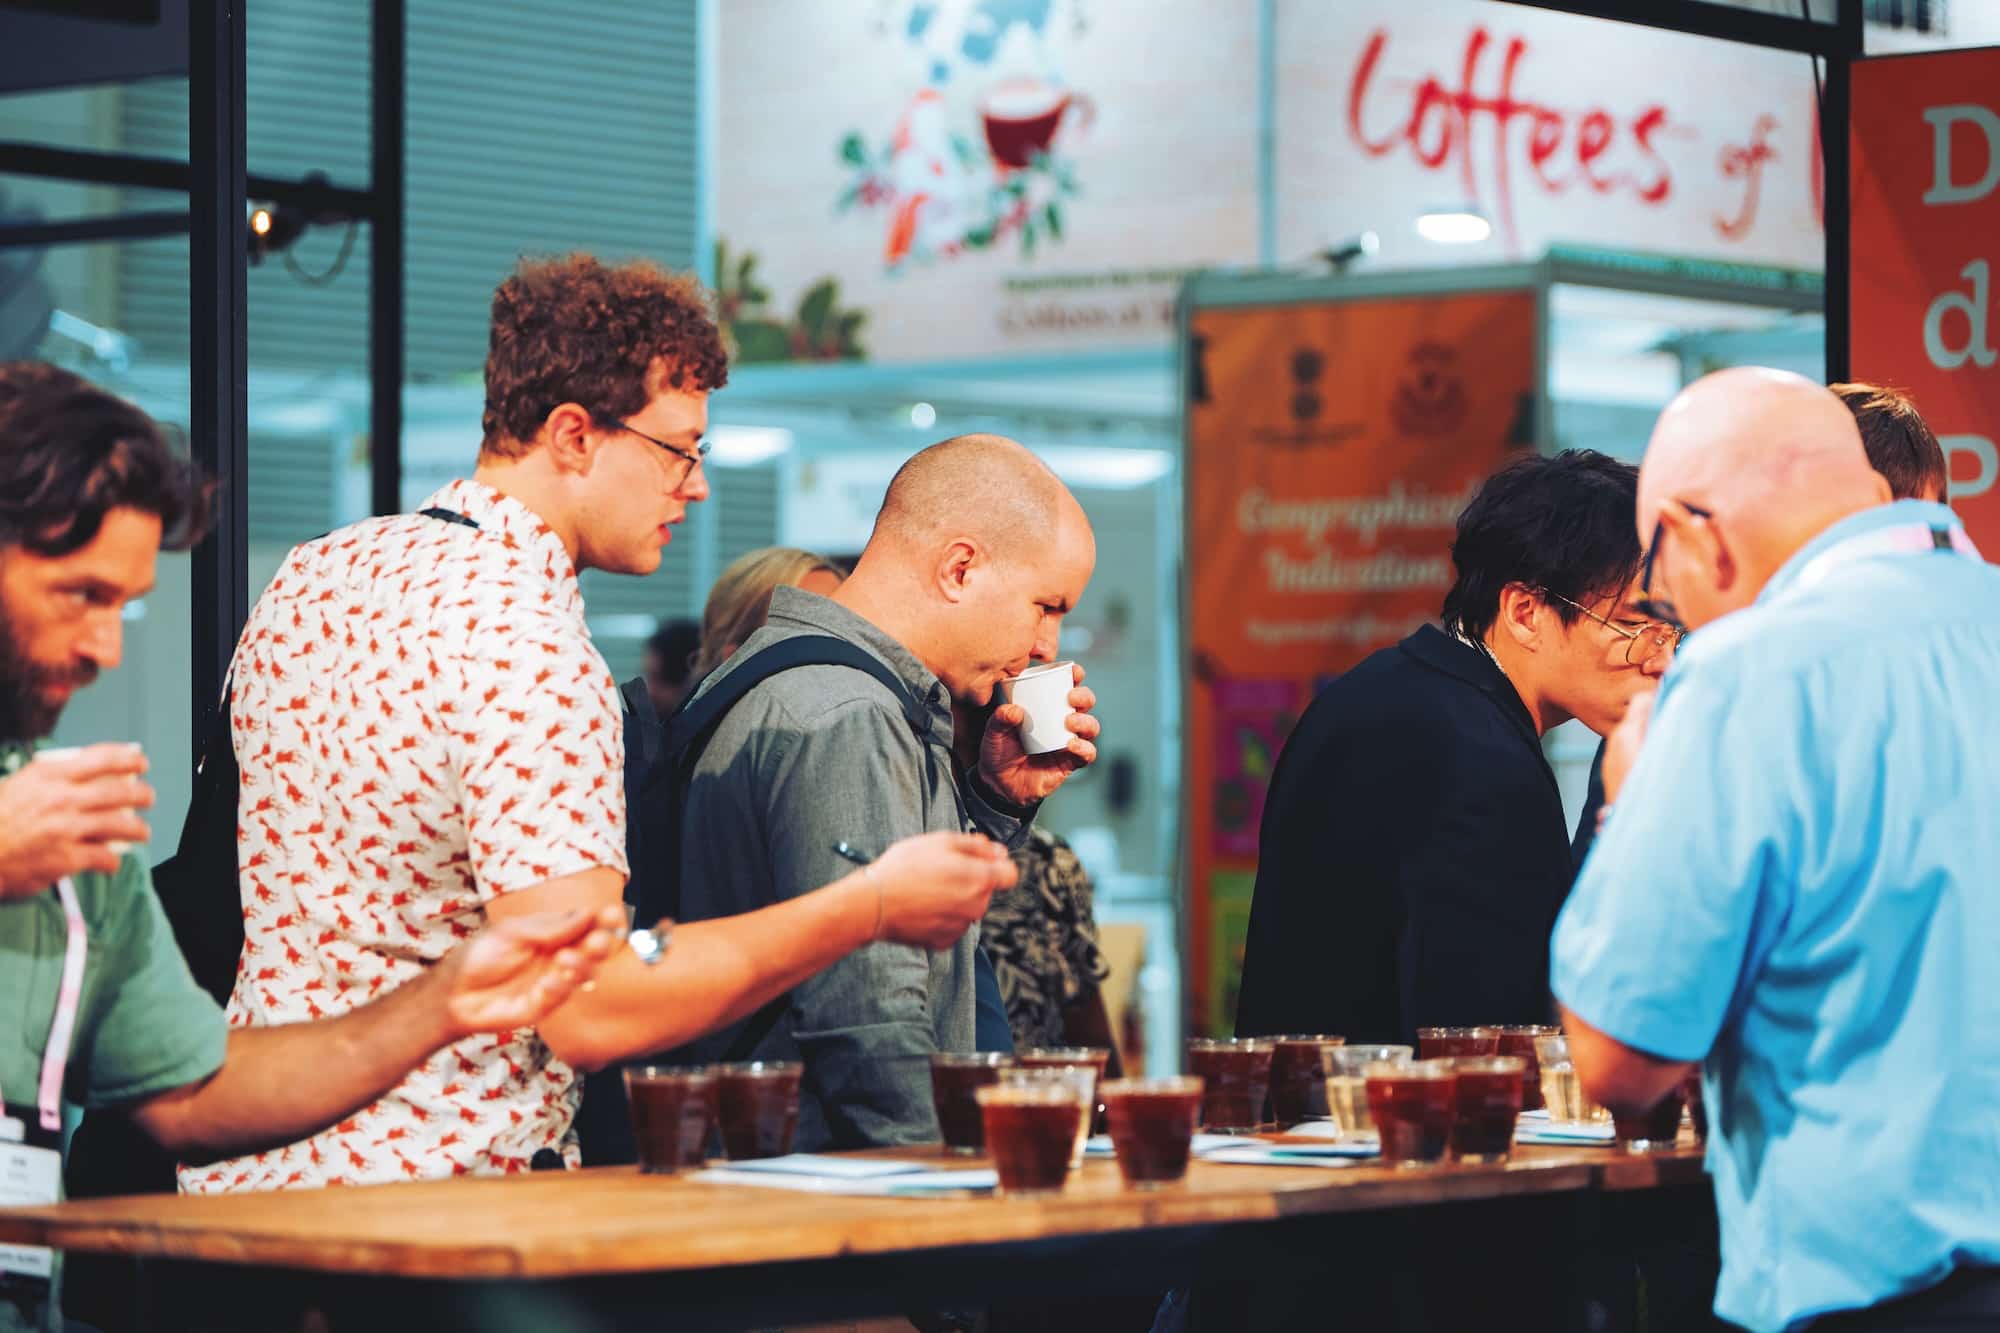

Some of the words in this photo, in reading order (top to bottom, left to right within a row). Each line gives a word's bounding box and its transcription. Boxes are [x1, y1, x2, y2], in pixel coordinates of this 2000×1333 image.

[1347, 27, 1678, 252] Coffees
[1714, 113, 1779, 240] of
[1266, 548, 1449, 590] Indication
